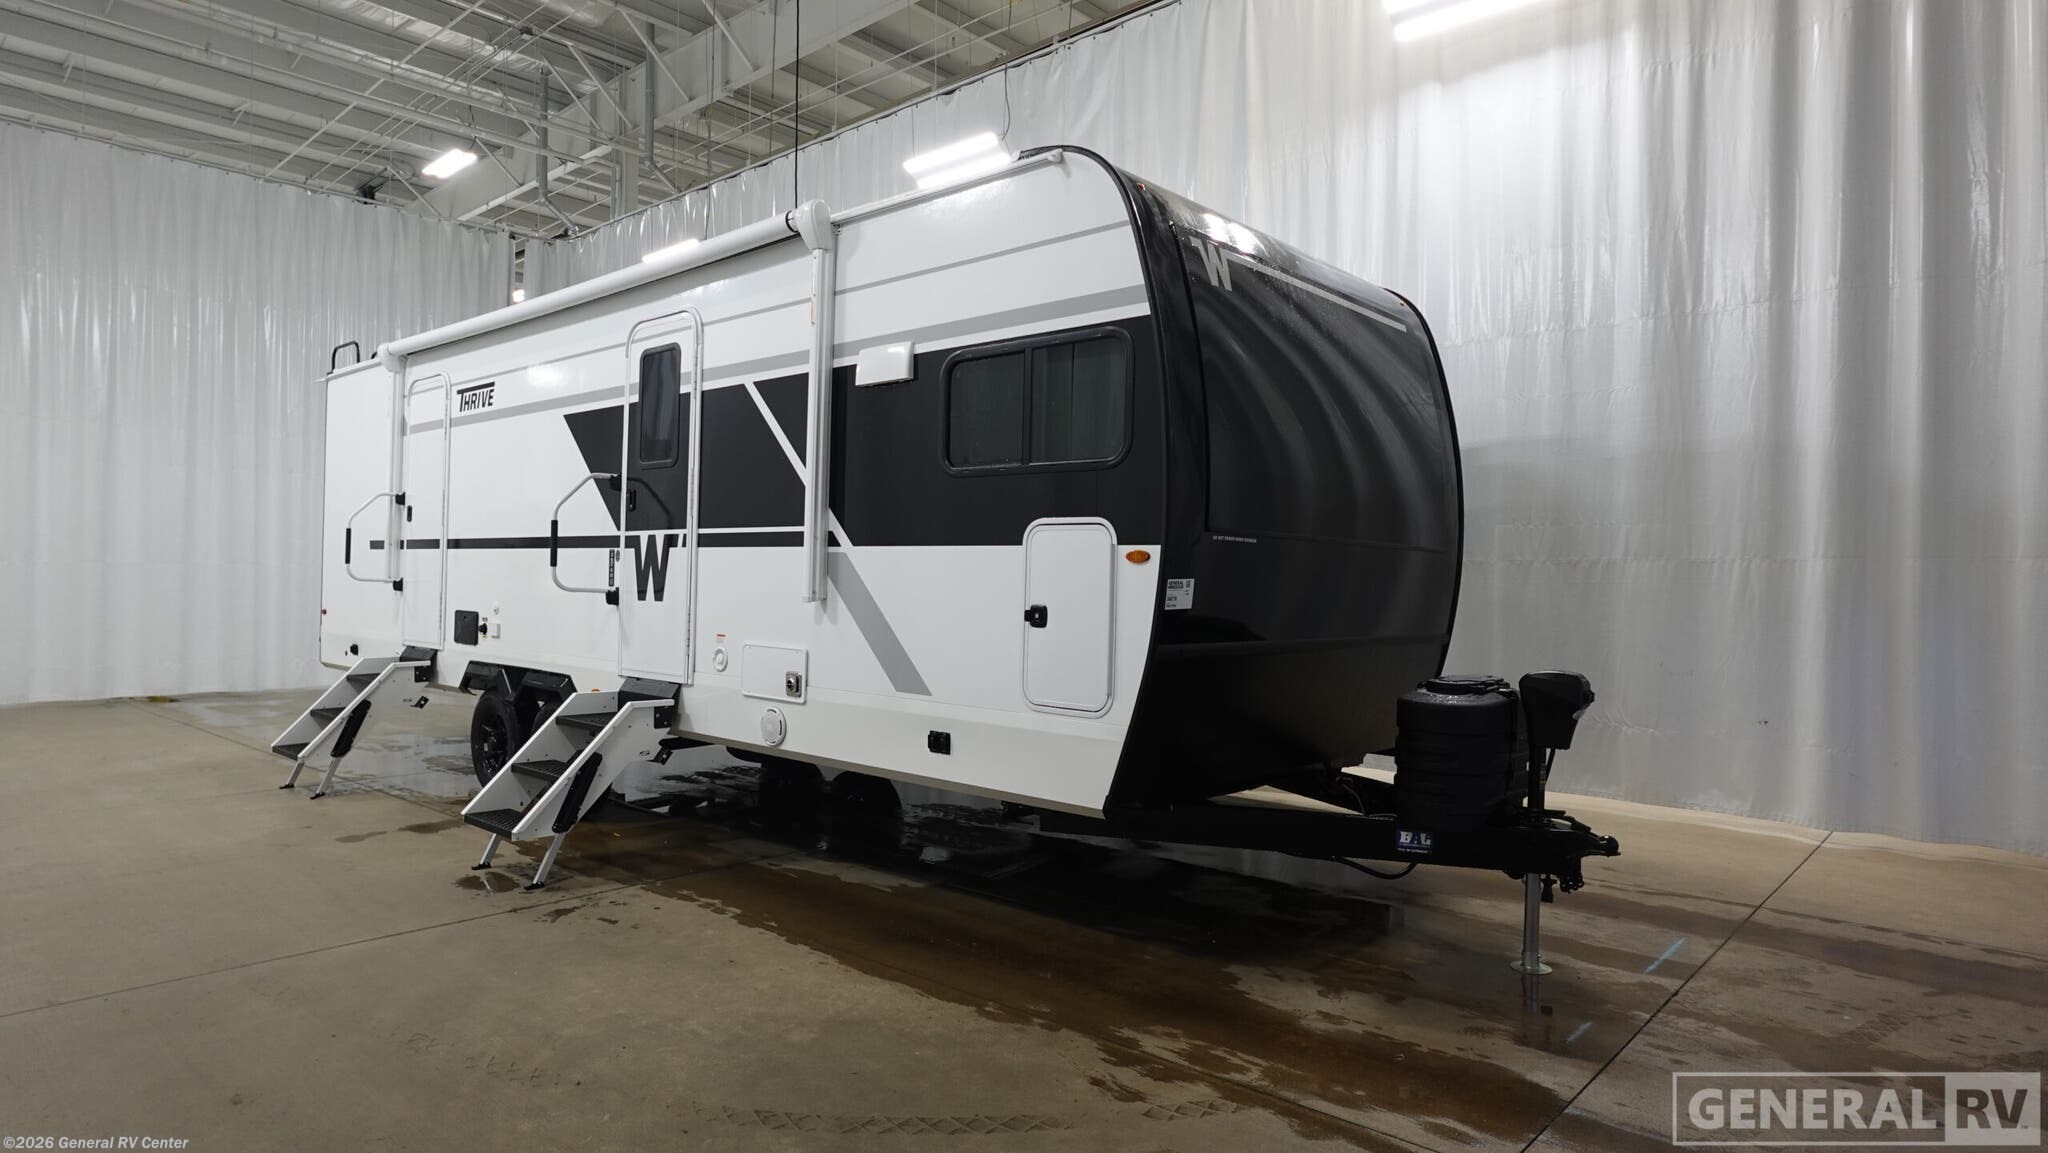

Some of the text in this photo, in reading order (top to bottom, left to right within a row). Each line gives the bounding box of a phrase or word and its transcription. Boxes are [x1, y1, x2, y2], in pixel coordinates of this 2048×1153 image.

[1189, 236, 1232, 291] W
[457, 381, 495, 412] THRIVE
[625, 533, 679, 602] W
